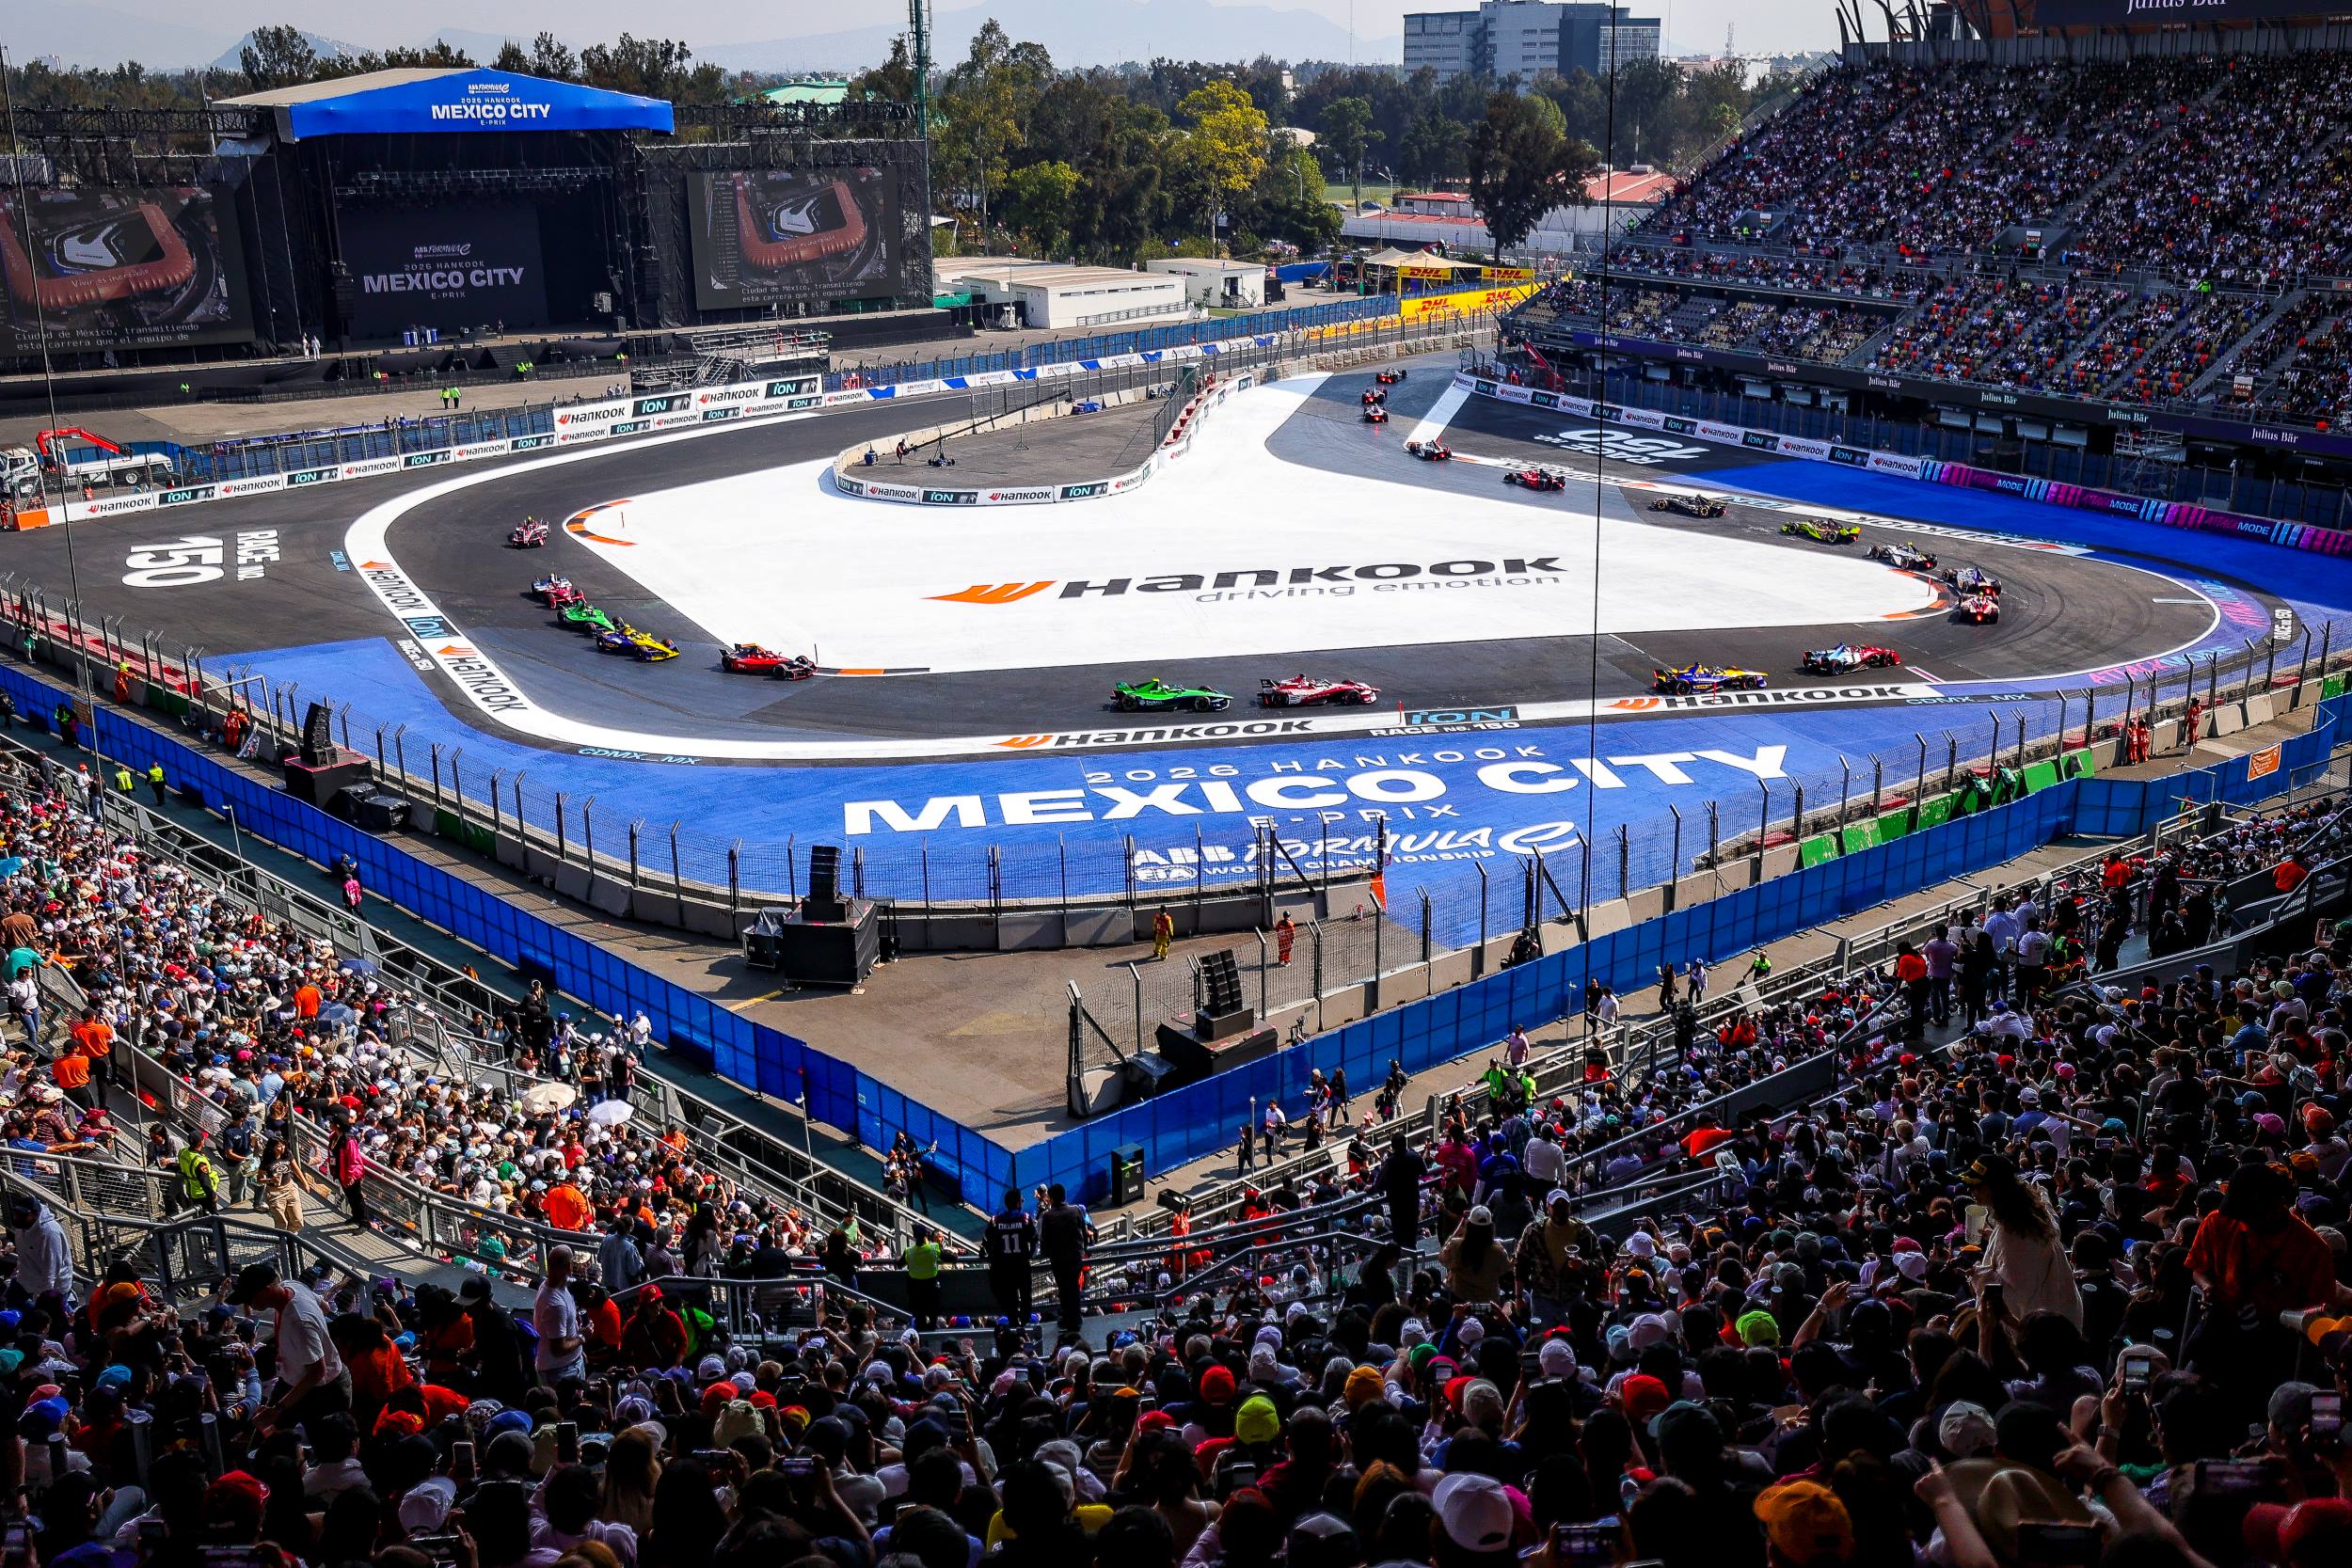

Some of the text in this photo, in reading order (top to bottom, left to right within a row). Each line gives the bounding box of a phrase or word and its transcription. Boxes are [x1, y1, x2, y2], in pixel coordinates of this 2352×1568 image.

[432, 103, 551, 119] MEXICO CITY
[437, 261, 485, 269] HANKOOK
[363, 267, 525, 293] MEXICO CITY
[1409, 268, 1442, 278] DHL
[1490, 268, 1522, 278] DHL
[741, 287, 768, 295] Ciudad
[815, 280, 866, 290] transmitiendo
[822, 290, 847, 298] equipo
[1486, 290, 1513, 304] DHL
[1422, 298, 1451, 312] DHL
[124, 323, 199, 335] transmitiendo
[49, 340, 90, 348] carrera
[96, 339, 114, 347] que
[120, 335, 132, 344] el
[137, 333, 172, 344] equipo
[1677, 349, 1692, 359] Julius
[1768, 361, 1797, 374] Julius Bär
[1868, 376, 1900, 389] Julius Bär
[710, 388, 759, 403] HANKOOK
[834, 391, 864, 403] HANKOOK
[1505, 388, 1530, 401] HANKOOK
[1981, 391, 2017, 405] Julius Bär
[571, 406, 625, 423] HANKOOK
[752, 403, 783, 413] HANKOOK
[1566, 401, 1590, 414] HANKOOK
[662, 414, 698, 425] HANKOOK
[1632, 412, 1661, 427] HANKOOK
[2107, 408, 2149, 423] Julius Bär
[568, 429, 606, 440] HANKOOK
[1708, 428, 1739, 441] HANKOOK
[2252, 427, 2299, 444] Julius Bär
[466, 444, 506, 457] HANKOOK
[1791, 442, 1826, 457] HANKOOK
[355, 459, 397, 473] HANKOOK
[1882, 457, 1920, 474] HANKOOK
[233, 479, 280, 493] HANKOOK
[1996, 478, 2023, 492] MODE
[878, 486, 917, 500] HANKOOK
[1001, 490, 1052, 501] HANKOOK
[100, 497, 151, 513] HANKOOK
[2109, 499, 2138, 514] MODE
[2237, 521, 2271, 536] MODE
[237, 529, 281, 564] RACE
[120, 535, 225, 588] 150
[1057, 557, 1571, 600] HANKOOK
[365, 569, 427, 611] HANKOOK
[1195, 576, 1562, 604] driving emotion
[444, 657, 529, 713] HANKOOK
[1664, 683, 1911, 709] HANKOOK
[1054, 721, 1315, 748] HANKOOK
[1370, 726, 1439, 737] RACE
[1471, 721, 1520, 731] 150
[1085, 745, 1547, 784] 2026 HANKOOK
[844, 744, 1788, 835] MEXICO CITY
[1248, 803, 1460, 830] E-PRIX
[1133, 844, 1237, 867] ABB
[1244, 825, 1493, 863] FORMULA
[1002, 1234, 1022, 1253] 11
